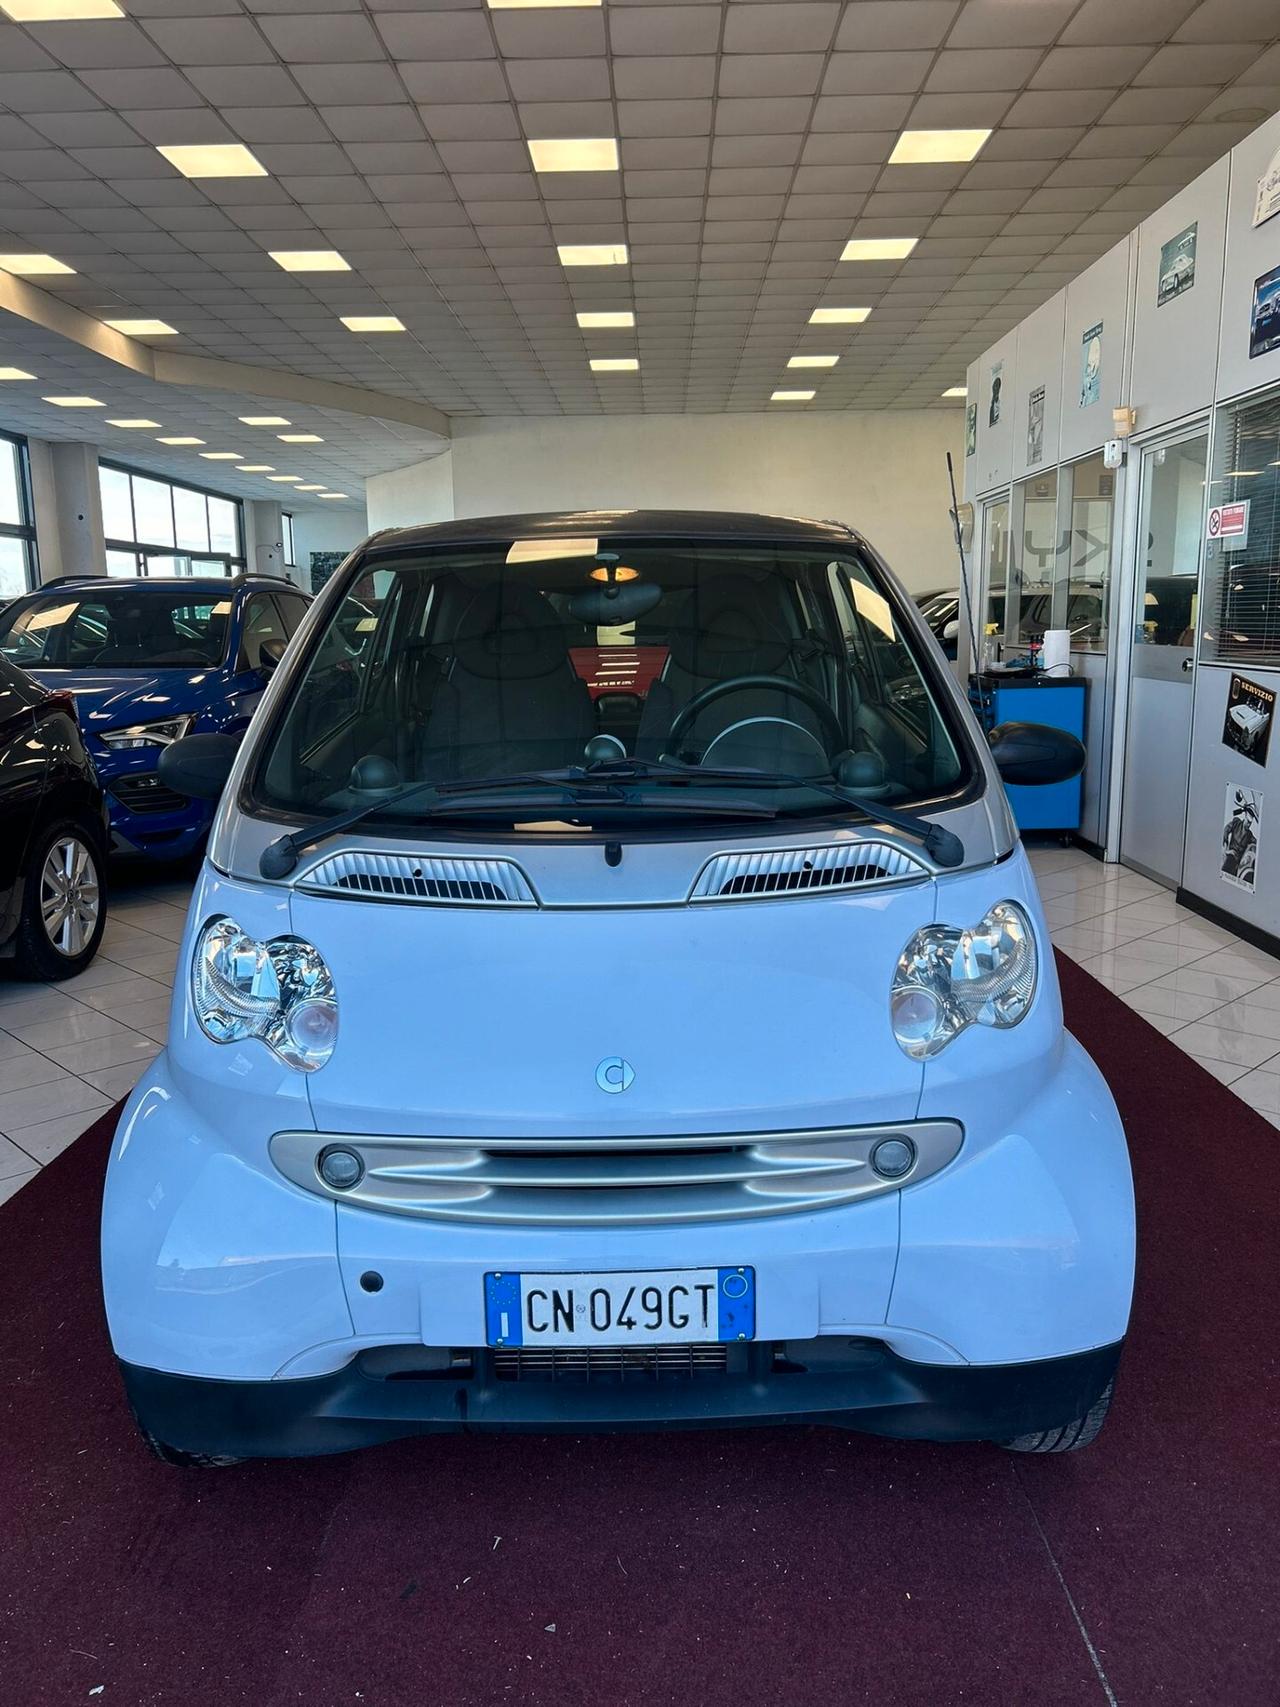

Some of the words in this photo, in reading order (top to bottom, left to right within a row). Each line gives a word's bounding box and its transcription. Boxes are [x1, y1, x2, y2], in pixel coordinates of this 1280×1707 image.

[1241, 681, 1274, 702] SERVIZIO
[526, 1289, 575, 1333] CN
[589, 1284, 716, 1332] 049GT
